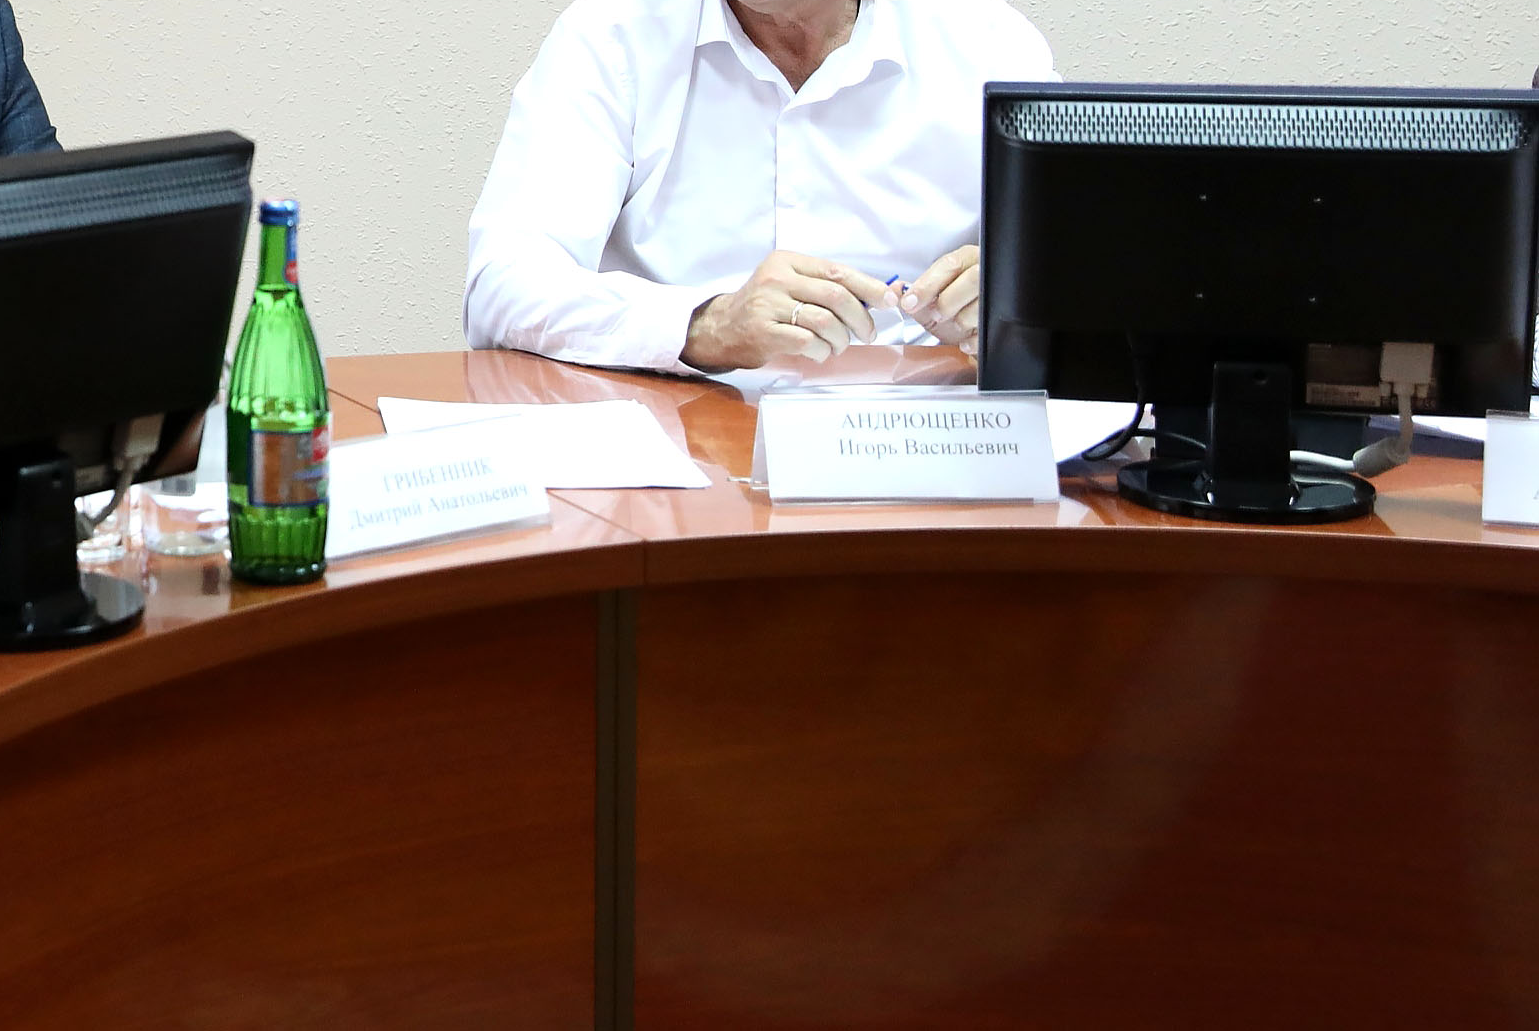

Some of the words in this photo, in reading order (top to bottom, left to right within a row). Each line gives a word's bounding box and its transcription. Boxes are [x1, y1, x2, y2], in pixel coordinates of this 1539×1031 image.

[840, 411, 1012, 432] АНДРЮЩЕНКО
[838, 438, 898, 459] Игорь
[904, 437, 1020, 456] Васильевич
